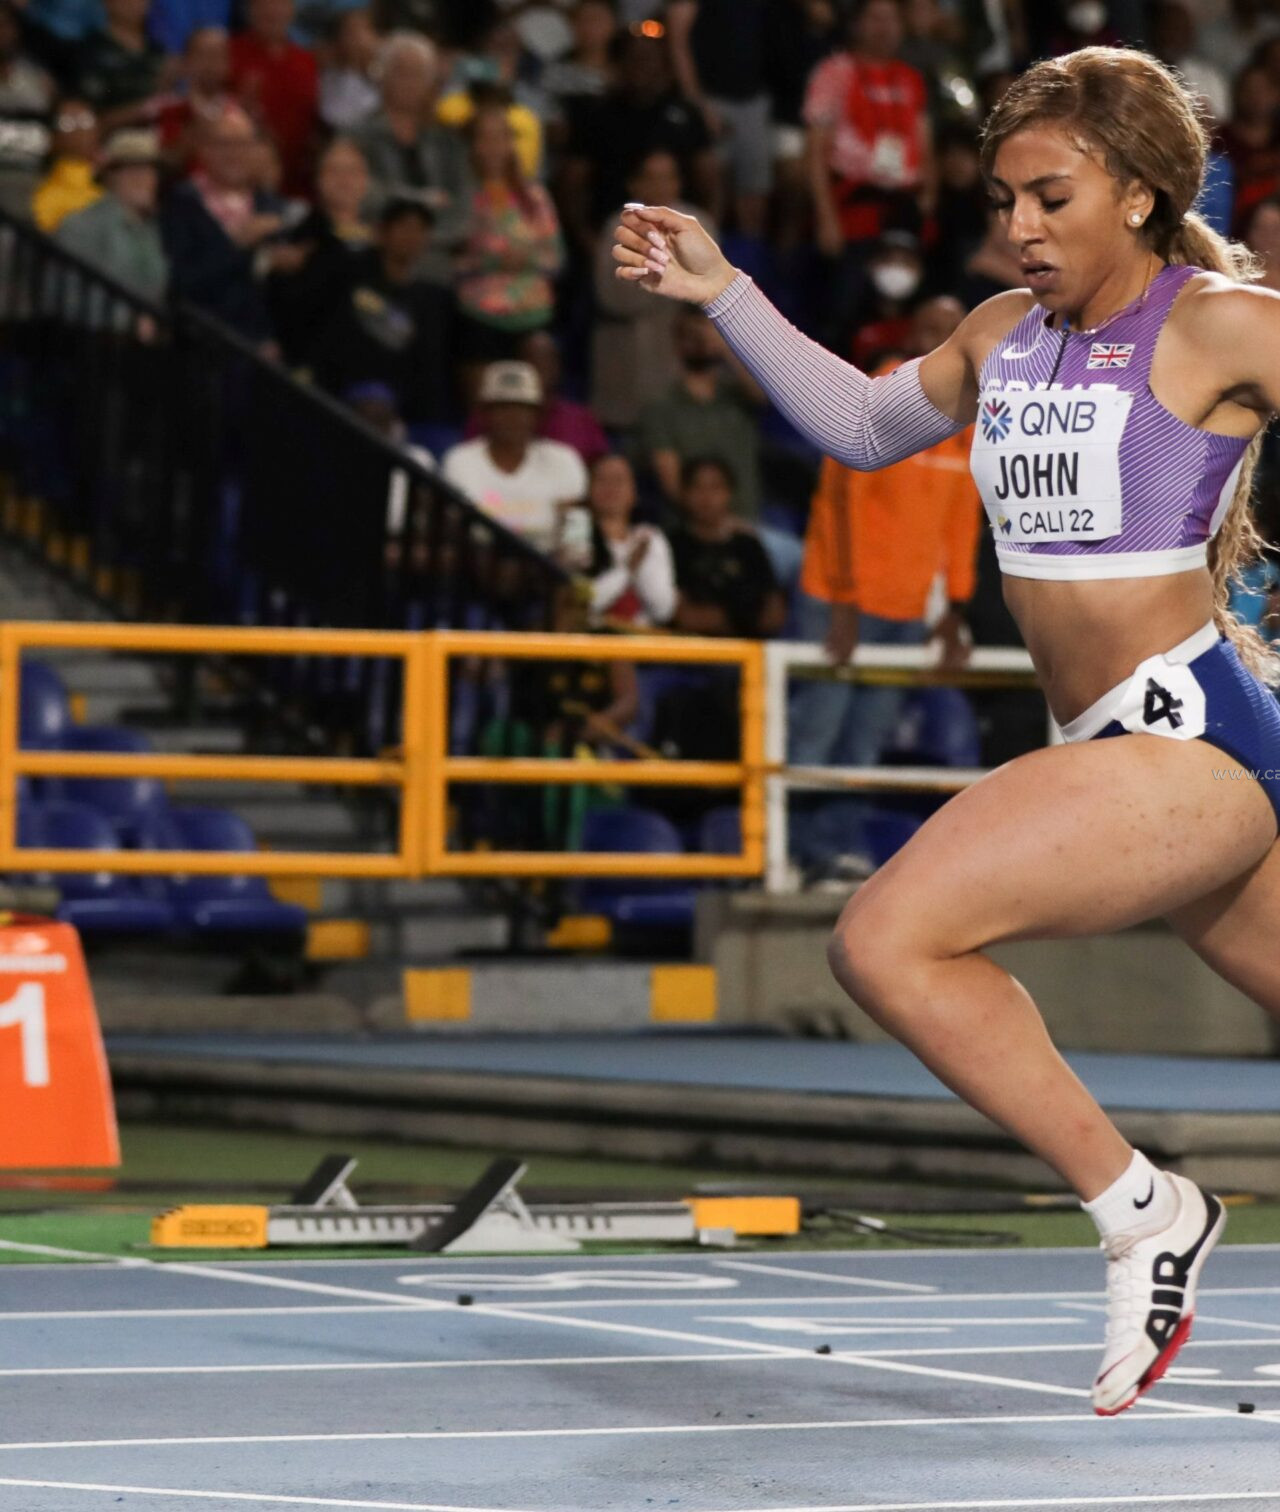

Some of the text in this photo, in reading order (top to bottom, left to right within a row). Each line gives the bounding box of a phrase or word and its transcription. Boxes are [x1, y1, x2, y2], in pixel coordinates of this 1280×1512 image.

[1020, 400, 1097, 436] QNB
[994, 452, 1079, 499] JOHN
[1019, 509, 1095, 534] CALI 22
[1142, 677, 1184, 730] 4
[0, 982, 50, 1087] 1
[1145, 1250, 1191, 1352] AIR
